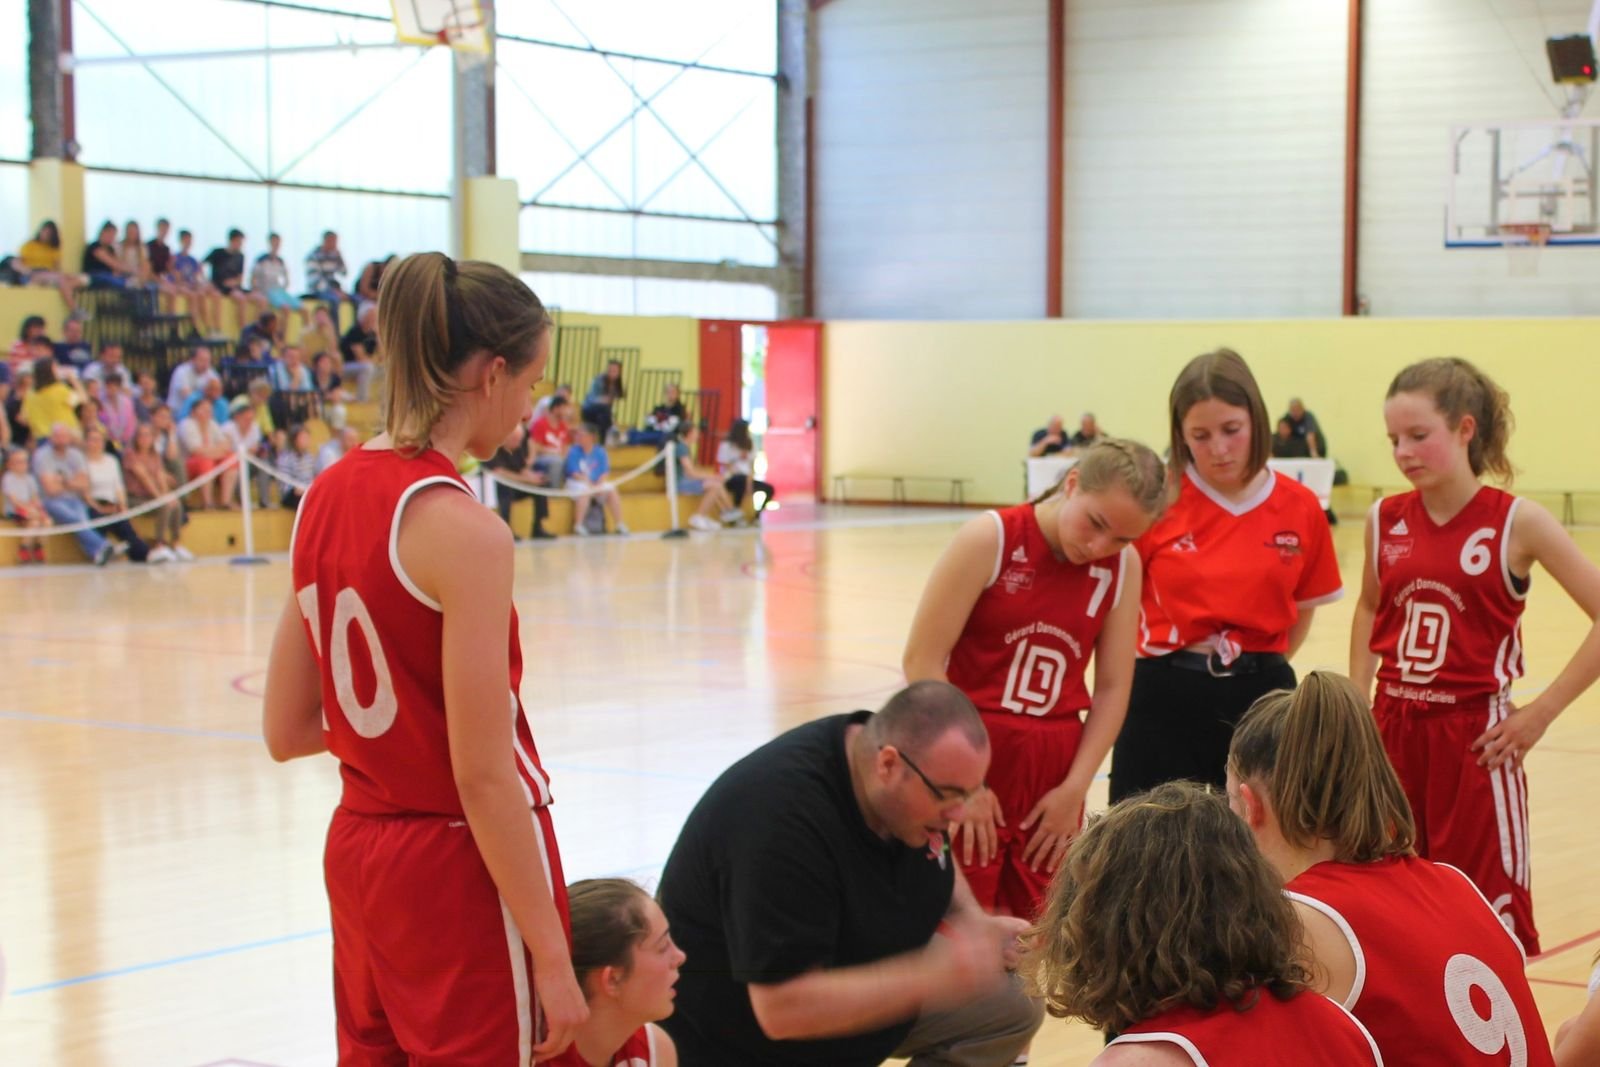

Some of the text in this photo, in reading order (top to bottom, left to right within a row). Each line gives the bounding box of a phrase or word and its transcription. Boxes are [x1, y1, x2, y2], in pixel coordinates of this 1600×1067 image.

[1460, 528, 1497, 576] 6
[1086, 565, 1113, 618] 7
[1444, 953, 1528, 1067] 9
